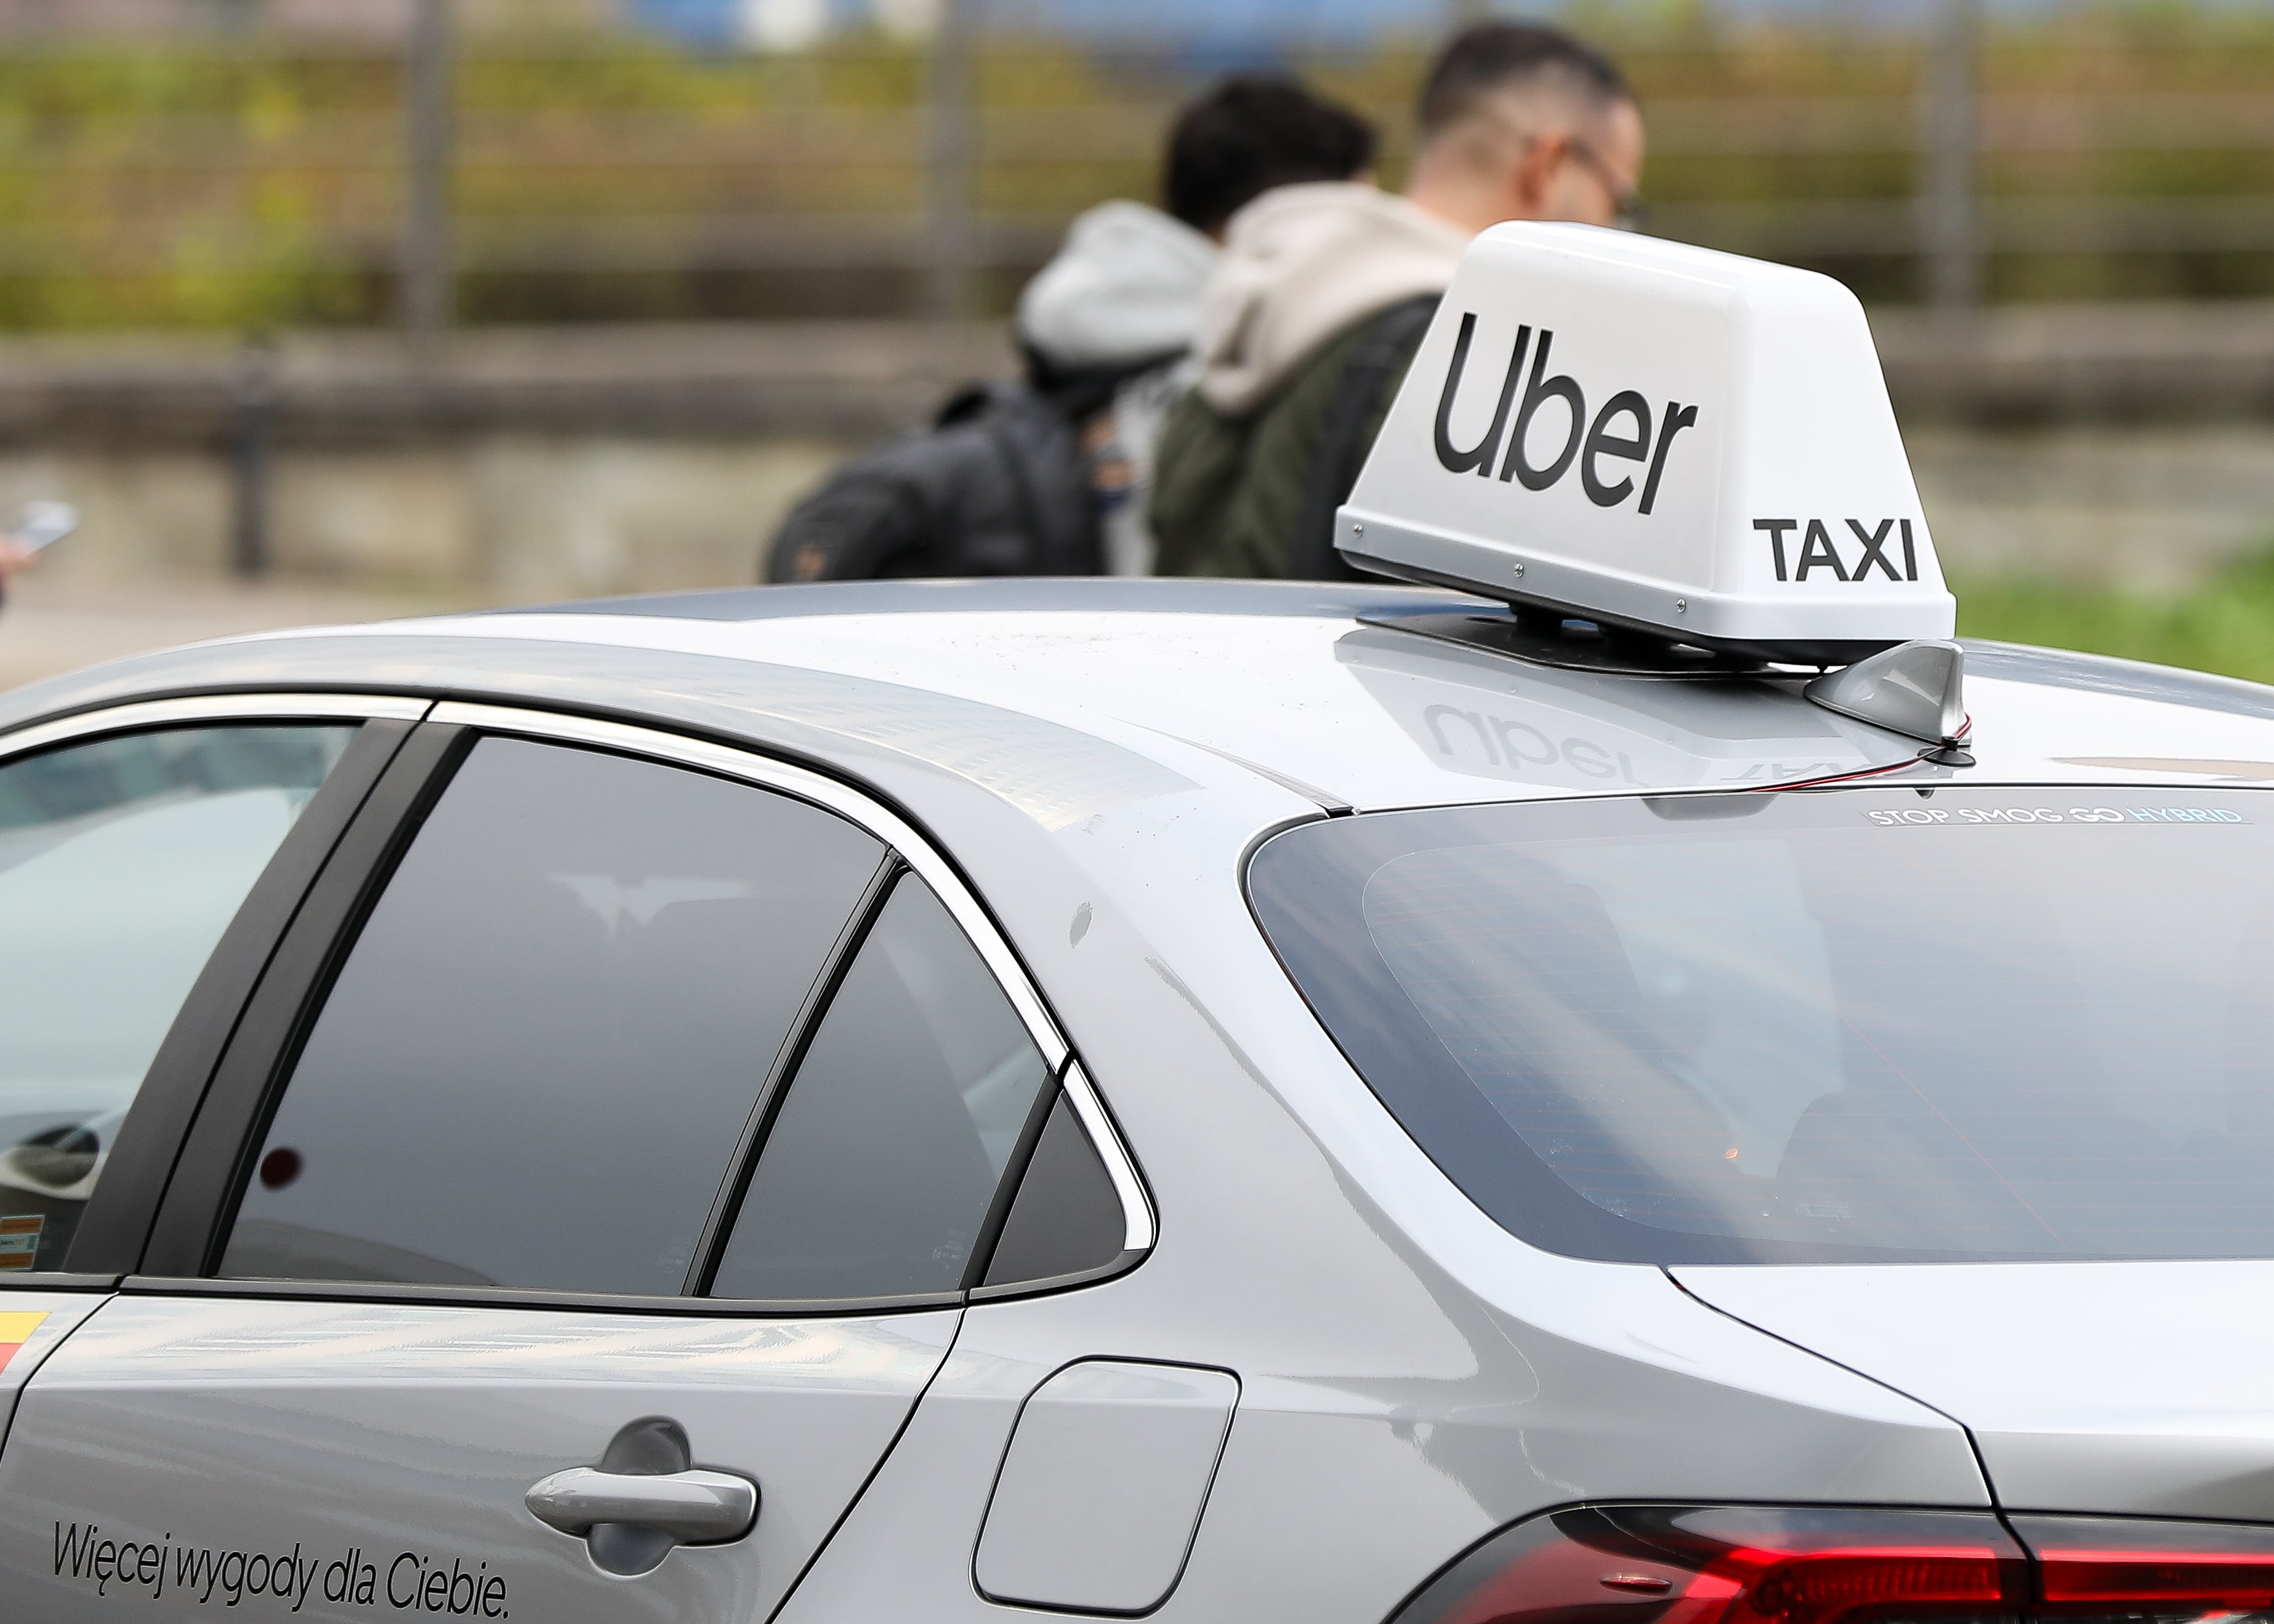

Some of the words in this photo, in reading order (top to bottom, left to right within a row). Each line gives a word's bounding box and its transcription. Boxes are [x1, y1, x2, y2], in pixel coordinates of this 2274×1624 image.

[1434, 312, 1699, 515] Uber
[1754, 518, 1917, 582] TAXI
[1868, 808, 1950, 826] STOP
[1957, 807, 2064, 824] SMOG
[2068, 807, 2126, 823] GO
[2126, 807, 2244, 823] HYBRID
[54, 1520, 171, 1600] Więcej
[176, 1542, 320, 1614] wygody
[323, 1546, 377, 1606] dla
[385, 1551, 509, 1620] Ciebie.
